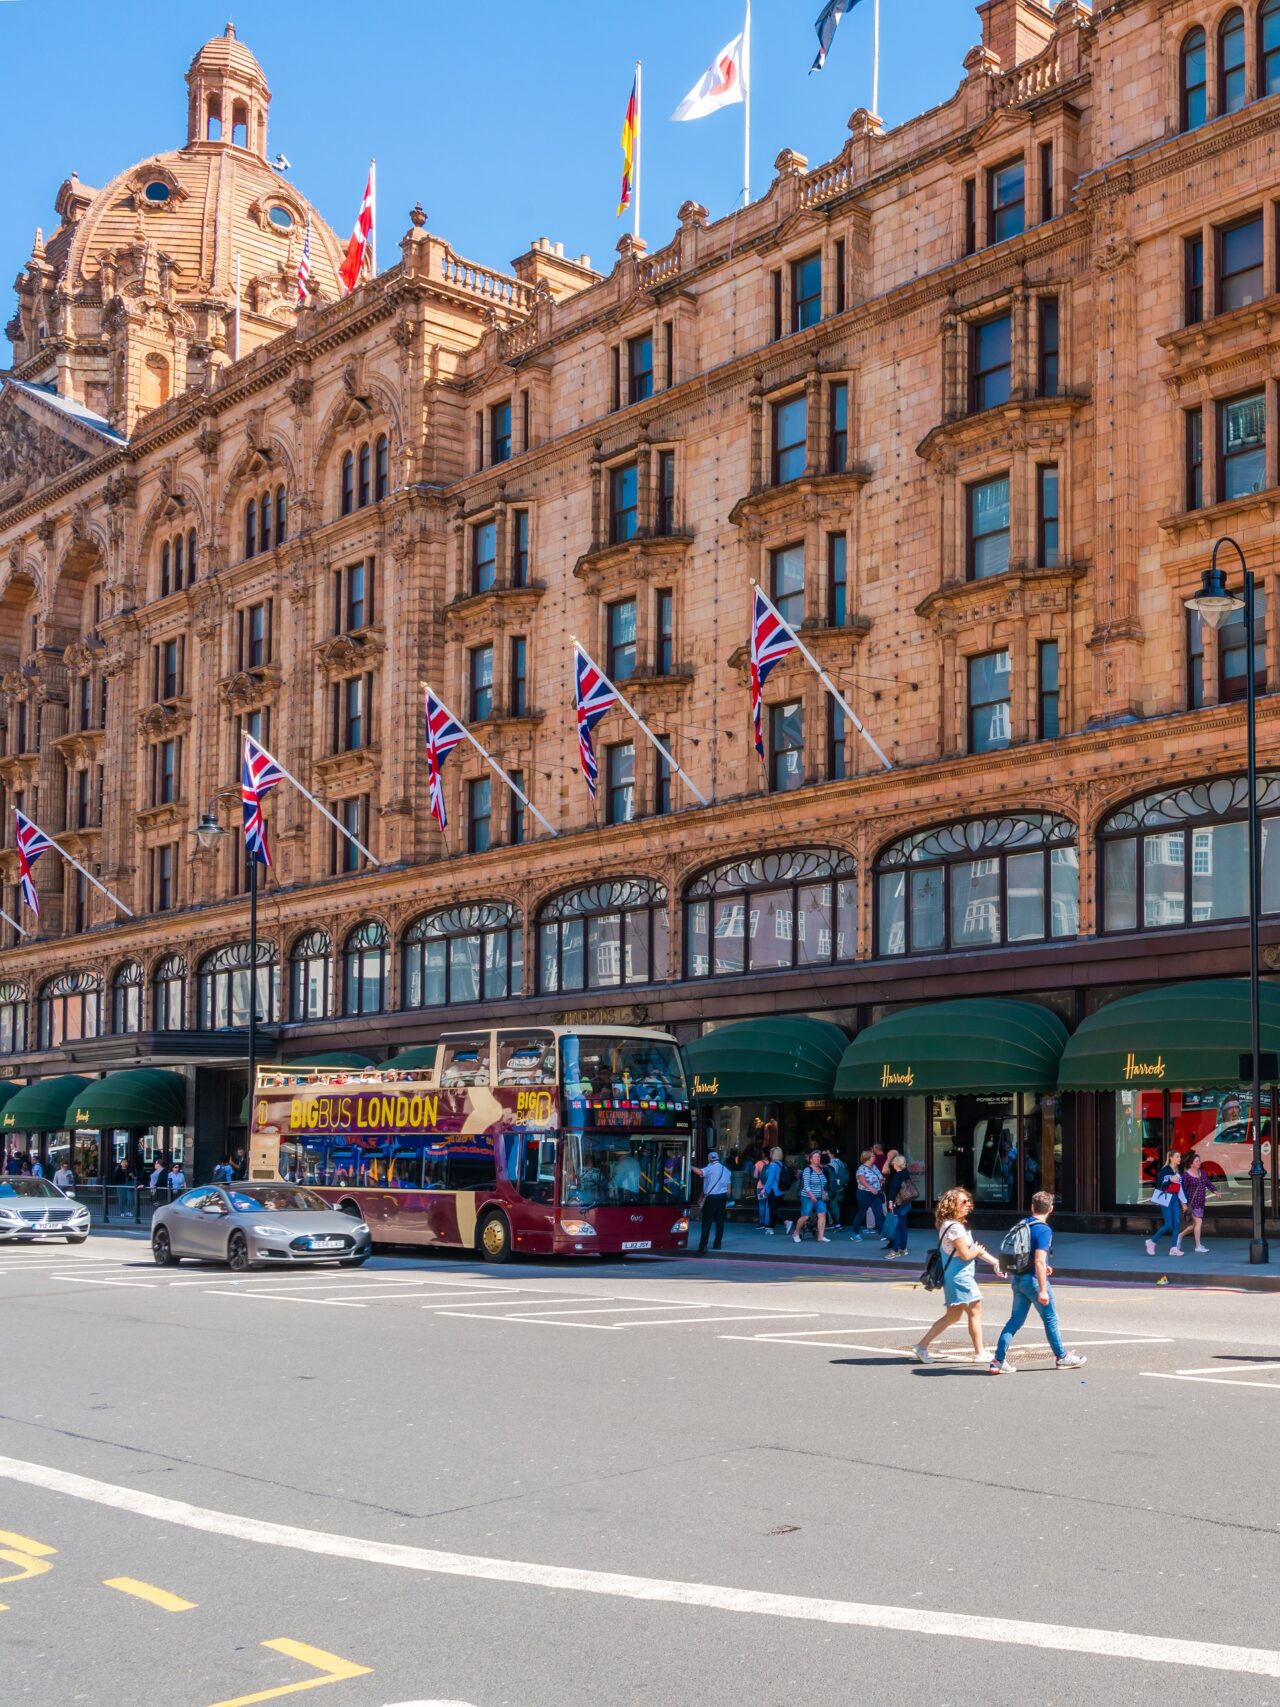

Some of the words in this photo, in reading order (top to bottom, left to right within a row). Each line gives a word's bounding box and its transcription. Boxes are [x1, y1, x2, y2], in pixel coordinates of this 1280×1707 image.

[880, 1064, 914, 1088] Harrods
[1122, 1053, 1166, 1080] Harrods
[357, 1095, 439, 1128] LONDON
[517, 1092, 537, 1110] BIG
[515, 1110, 536, 1127] BUS
